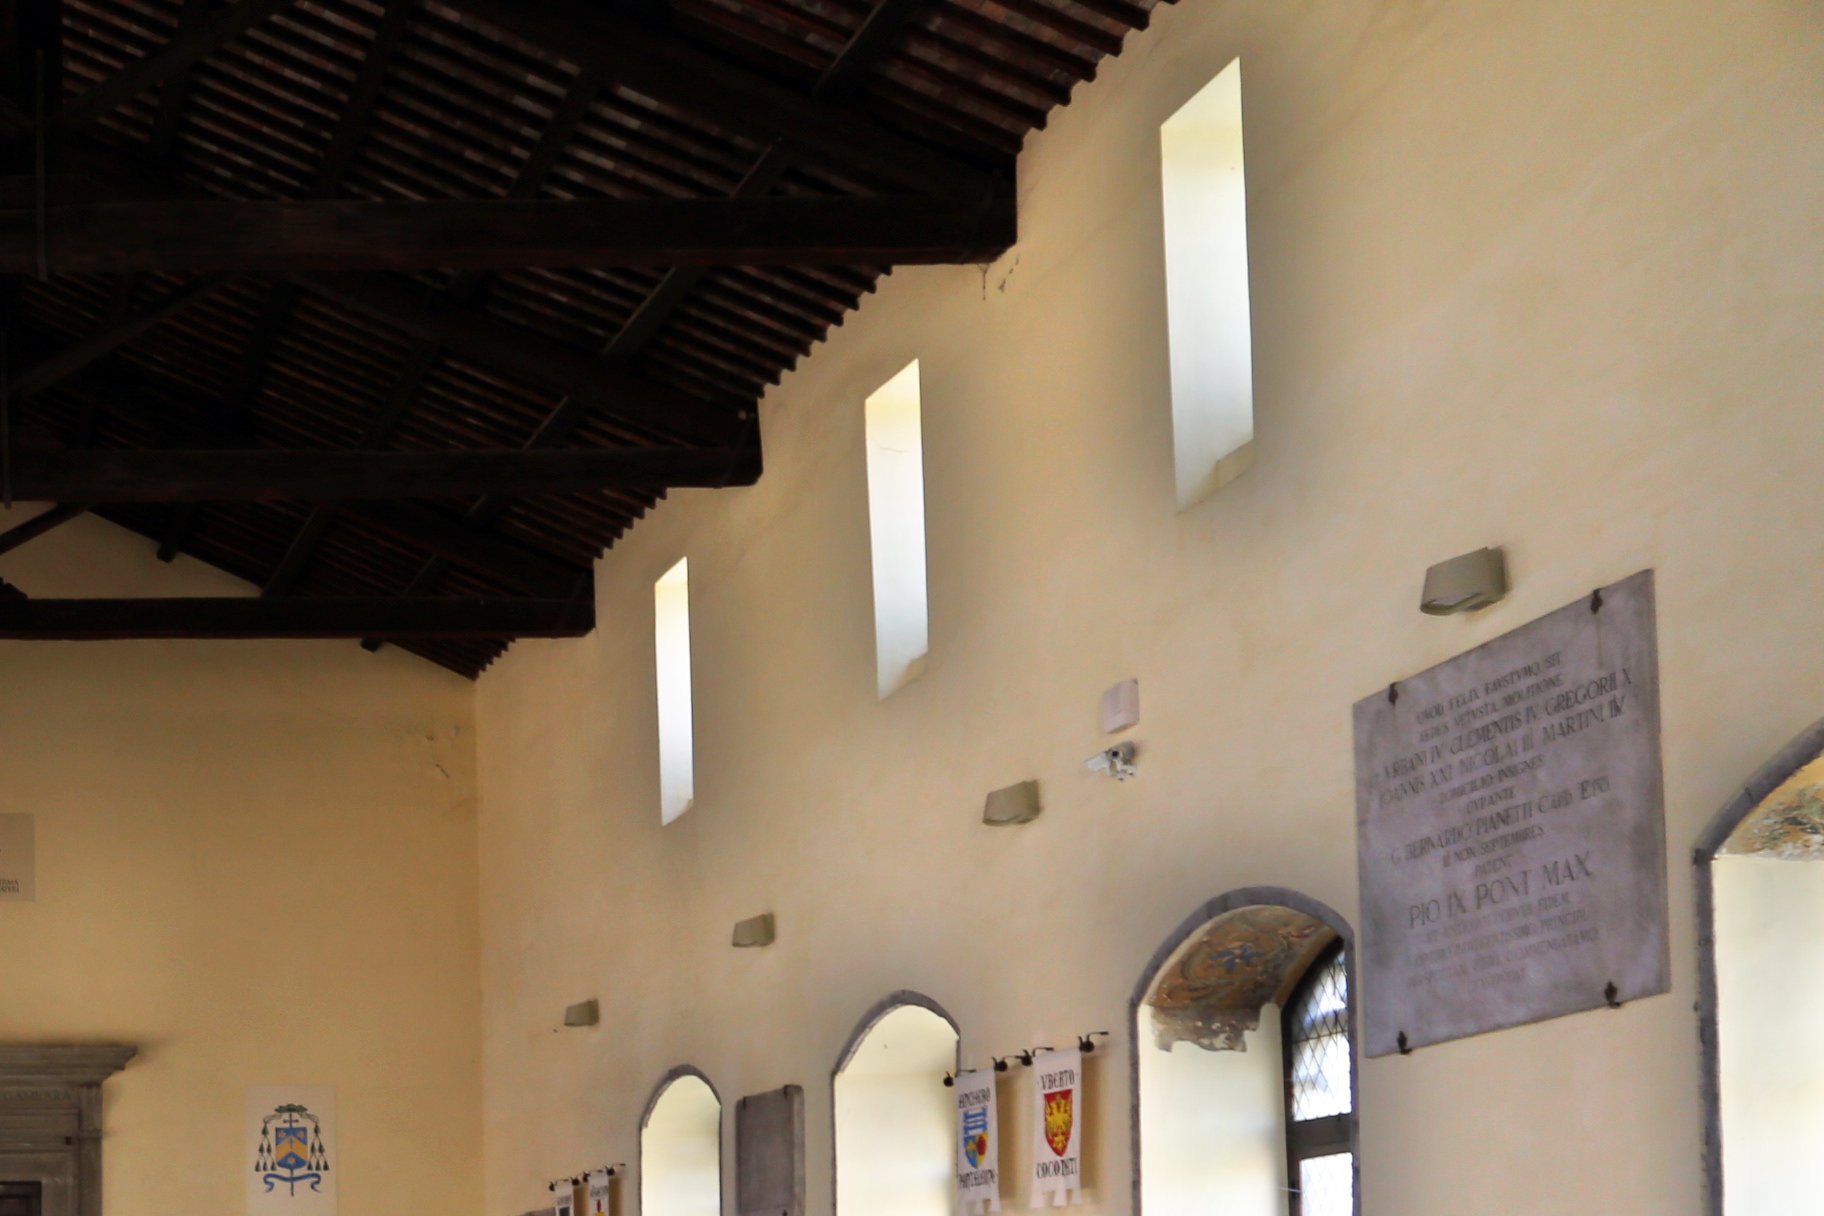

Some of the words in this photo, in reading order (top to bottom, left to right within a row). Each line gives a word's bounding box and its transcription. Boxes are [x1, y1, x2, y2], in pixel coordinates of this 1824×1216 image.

[1449, 712, 1521, 755] CLEMENTIS
[1544, 674, 1617, 718] GREGORII
[1621, 668, 1632, 688] X
[1459, 738, 1517, 776] NICOLAI
[1542, 705, 1604, 745] MARTINI
[1404, 823, 1471, 860] BERNARDO
[1475, 801, 1533, 836] PIANETTI
[1408, 898, 1441, 929] PIO
[1447, 890, 1467, 917] IX
[1475, 870, 1531, 909] PONT
[1542, 851, 1594, 890] MAX
